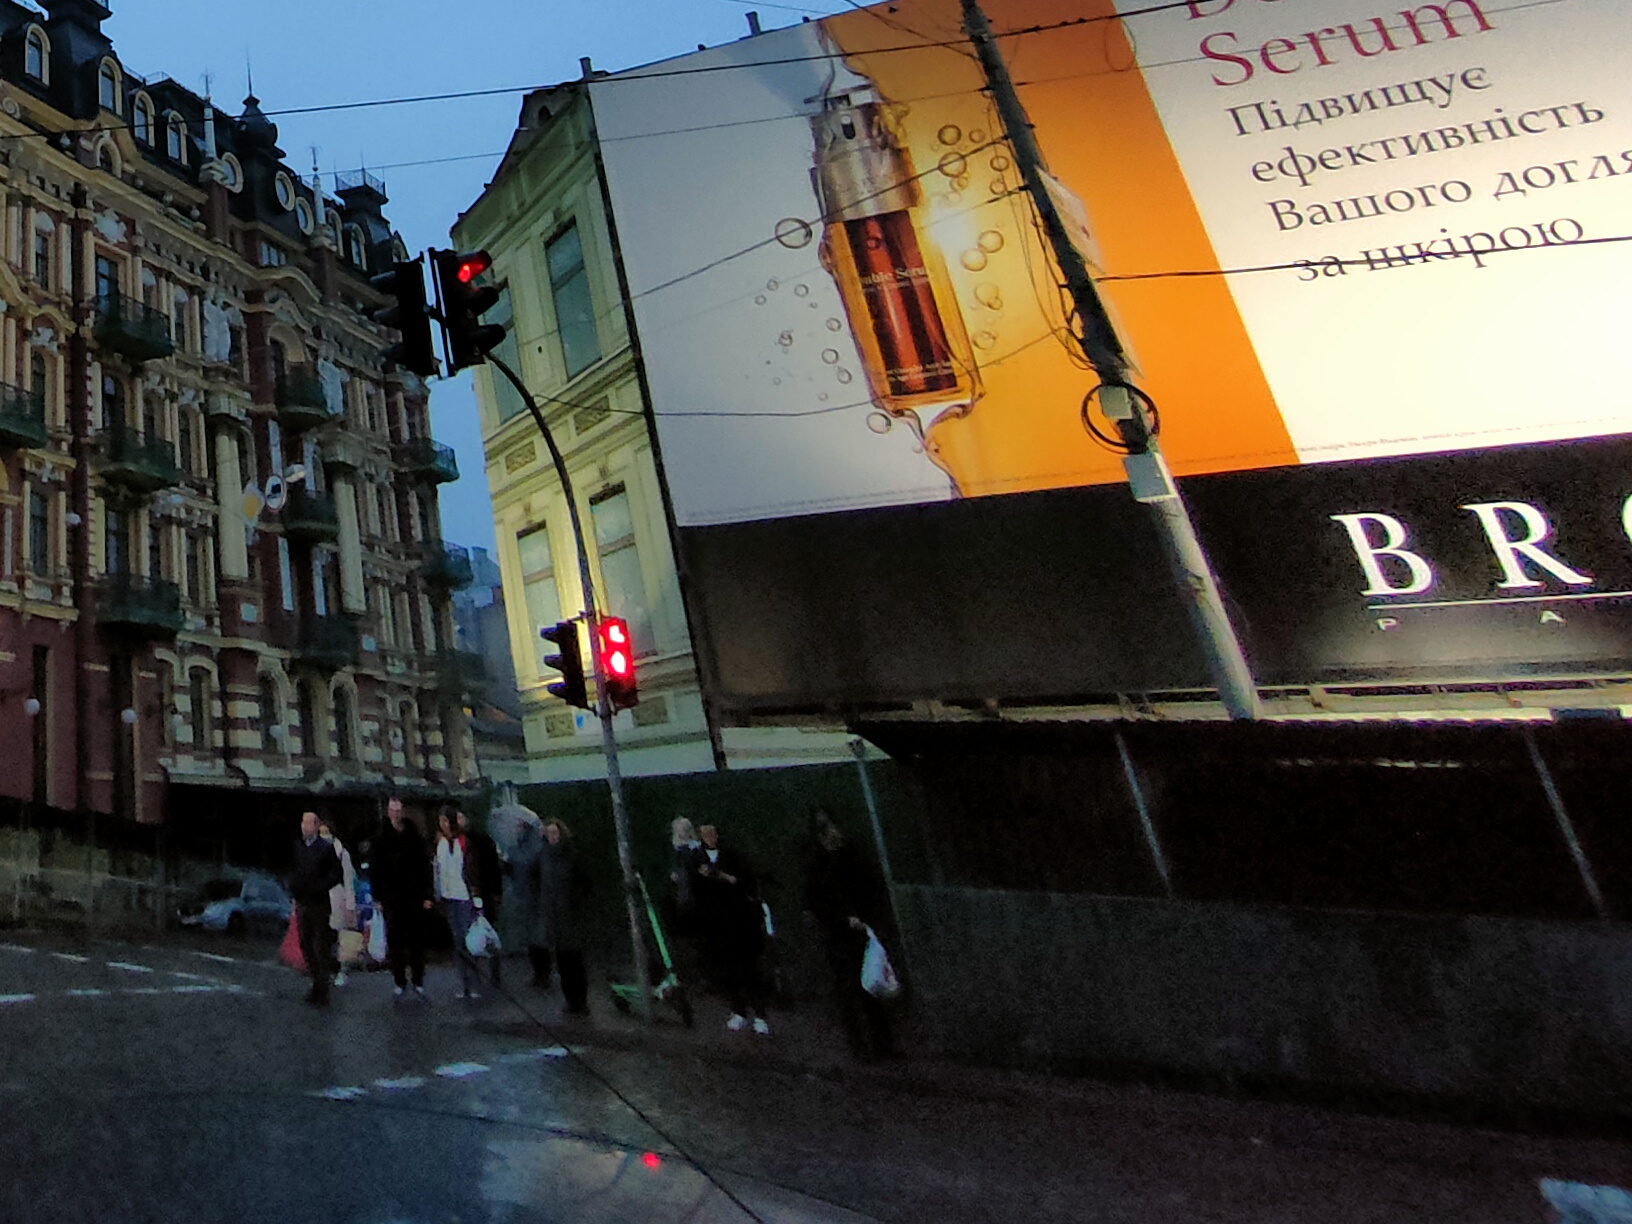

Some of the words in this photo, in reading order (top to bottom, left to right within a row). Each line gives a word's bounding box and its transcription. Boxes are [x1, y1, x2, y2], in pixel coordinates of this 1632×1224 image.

[1225, 65, 1494, 137] Підвищує
[1250, 99, 1605, 188] ефективність
[1267, 179, 1472, 234] Вашого
[1295, 257, 1348, 284] за
[1362, 215, 1585, 270] шкірою
[1329, 492, 1632, 597] BR
